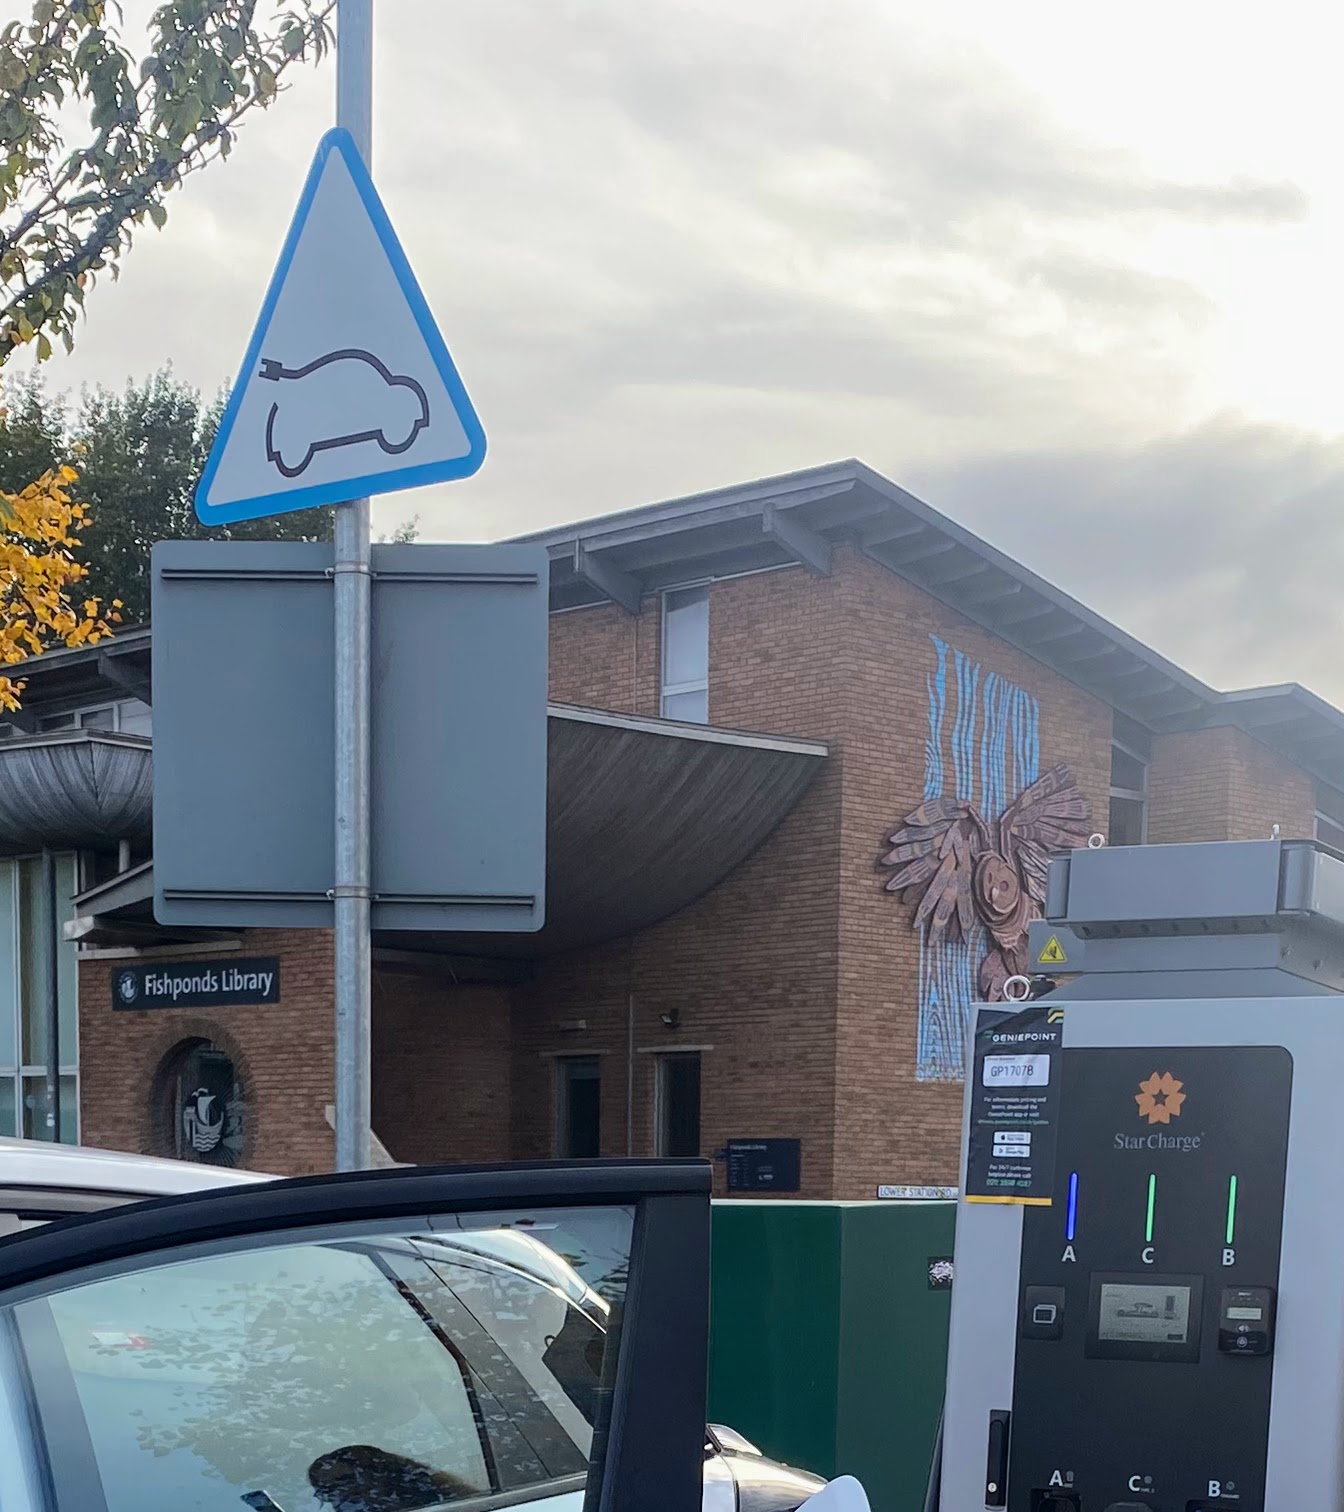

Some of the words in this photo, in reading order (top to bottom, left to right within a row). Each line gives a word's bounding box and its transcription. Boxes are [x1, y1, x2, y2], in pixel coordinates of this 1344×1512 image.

[145, 970, 218, 1000] Fishponds
[222, 968, 273, 996] Library
[992, 1033, 1056, 1042] GENIEPOINT
[880, 1187, 907, 1197] LOWER
[909, 1187, 938, 1197] STATION
[1062, 1246, 1076, 1262] A
[1141, 1247, 1154, 1264] C
[1222, 1249, 1235, 1266] B
[1049, 1470, 1063, 1487] A
[1128, 1475, 1141, 1492] C
[1208, 1480, 1221, 1497] B
